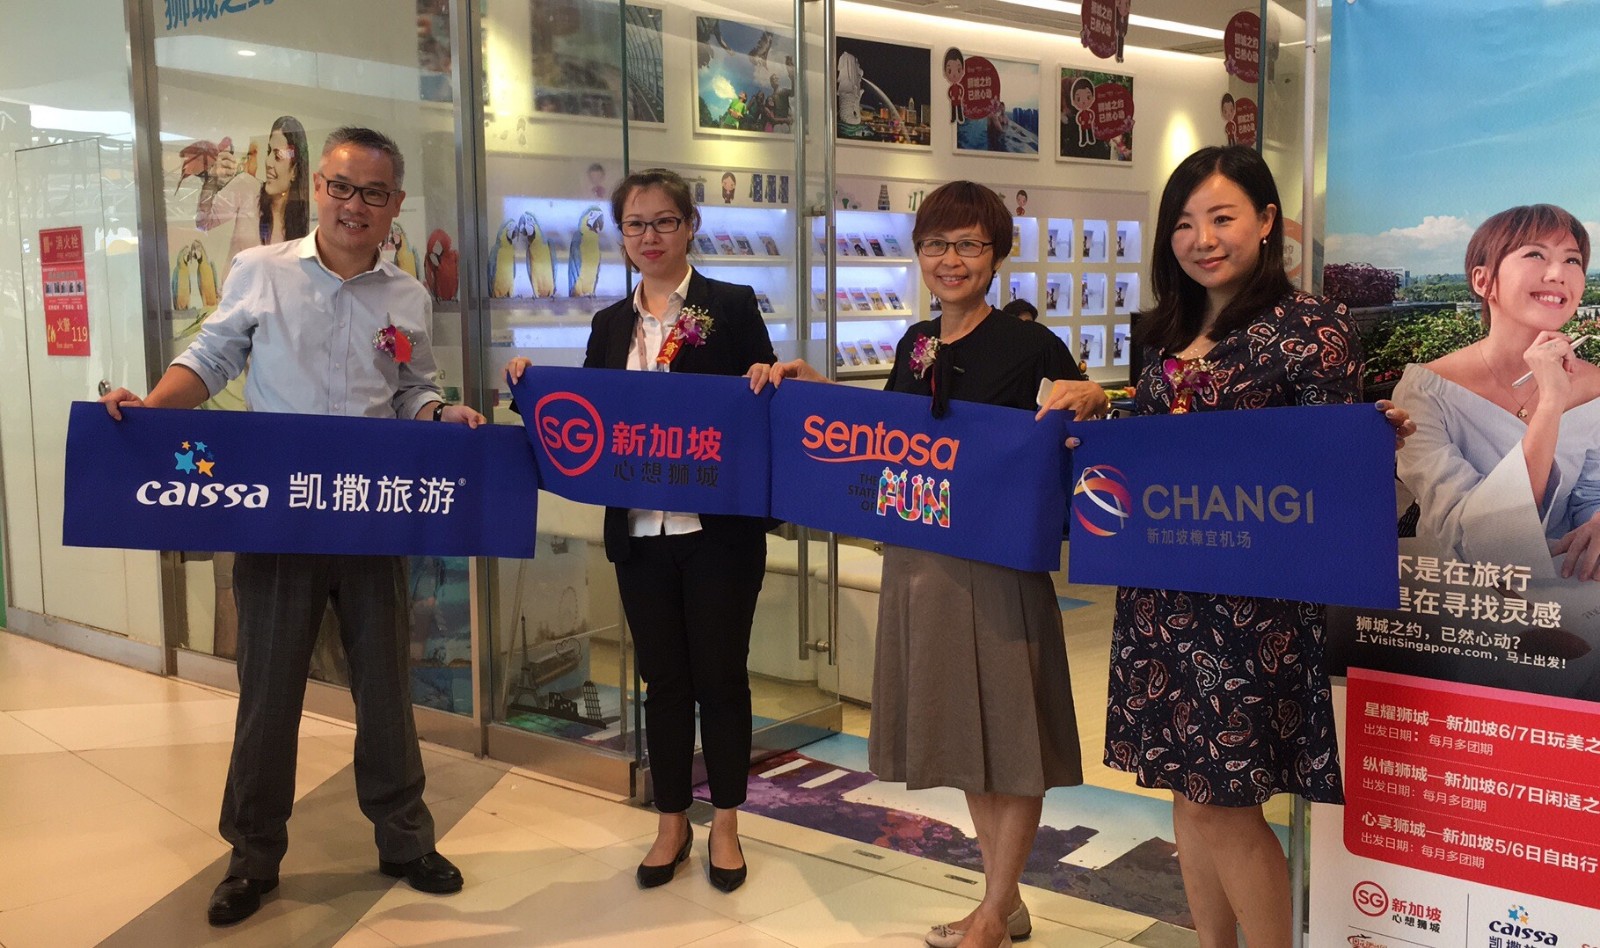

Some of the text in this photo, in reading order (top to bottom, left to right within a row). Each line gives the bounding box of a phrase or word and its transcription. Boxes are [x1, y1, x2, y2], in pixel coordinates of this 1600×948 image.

[55, 233, 79, 250] 消火栓
[71, 326, 88, 342] 119
[541, 415, 595, 455] SG
[611, 421, 722, 462] 新加坡
[860, 473, 878, 486] THE
[136, 480, 269, 510] caissa
[288, 472, 456, 516] 凯撒旅游
[848, 485, 877, 499] STATE
[876, 467, 950, 528] FUN
[860, 500, 875, 512] OF
[1146, 527, 1251, 549] 新加坡樟宜机场
[1358, 888, 1384, 909] SG
[1391, 898, 1442, 923] 新加坡
[1488, 920, 1559, 946] caissa
